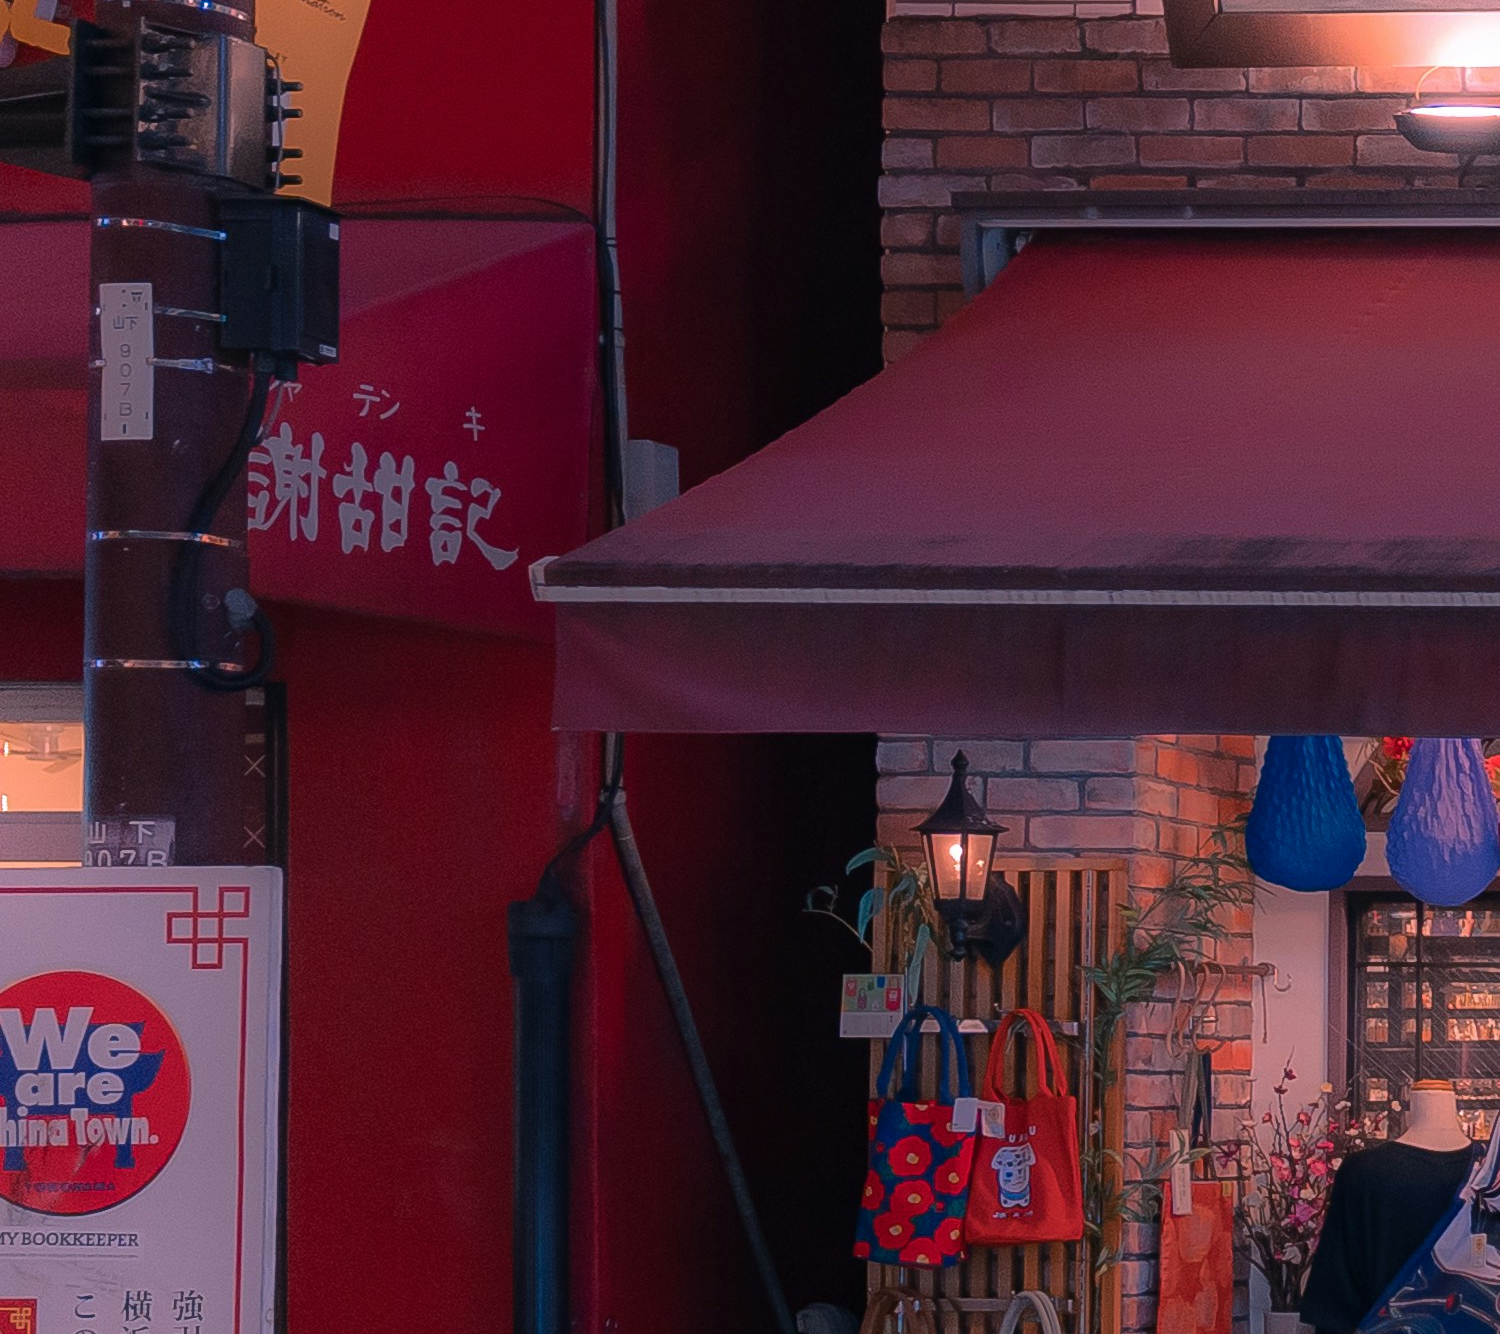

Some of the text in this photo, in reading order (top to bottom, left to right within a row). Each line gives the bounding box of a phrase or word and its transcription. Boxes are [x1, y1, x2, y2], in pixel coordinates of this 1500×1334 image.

[1, 1006, 141, 1071] We
[15, 1071, 125, 1106] are
[0, 1107, 160, 1148] hina Town.
[22, 1231, 139, 1247] BOOKKEEPER
